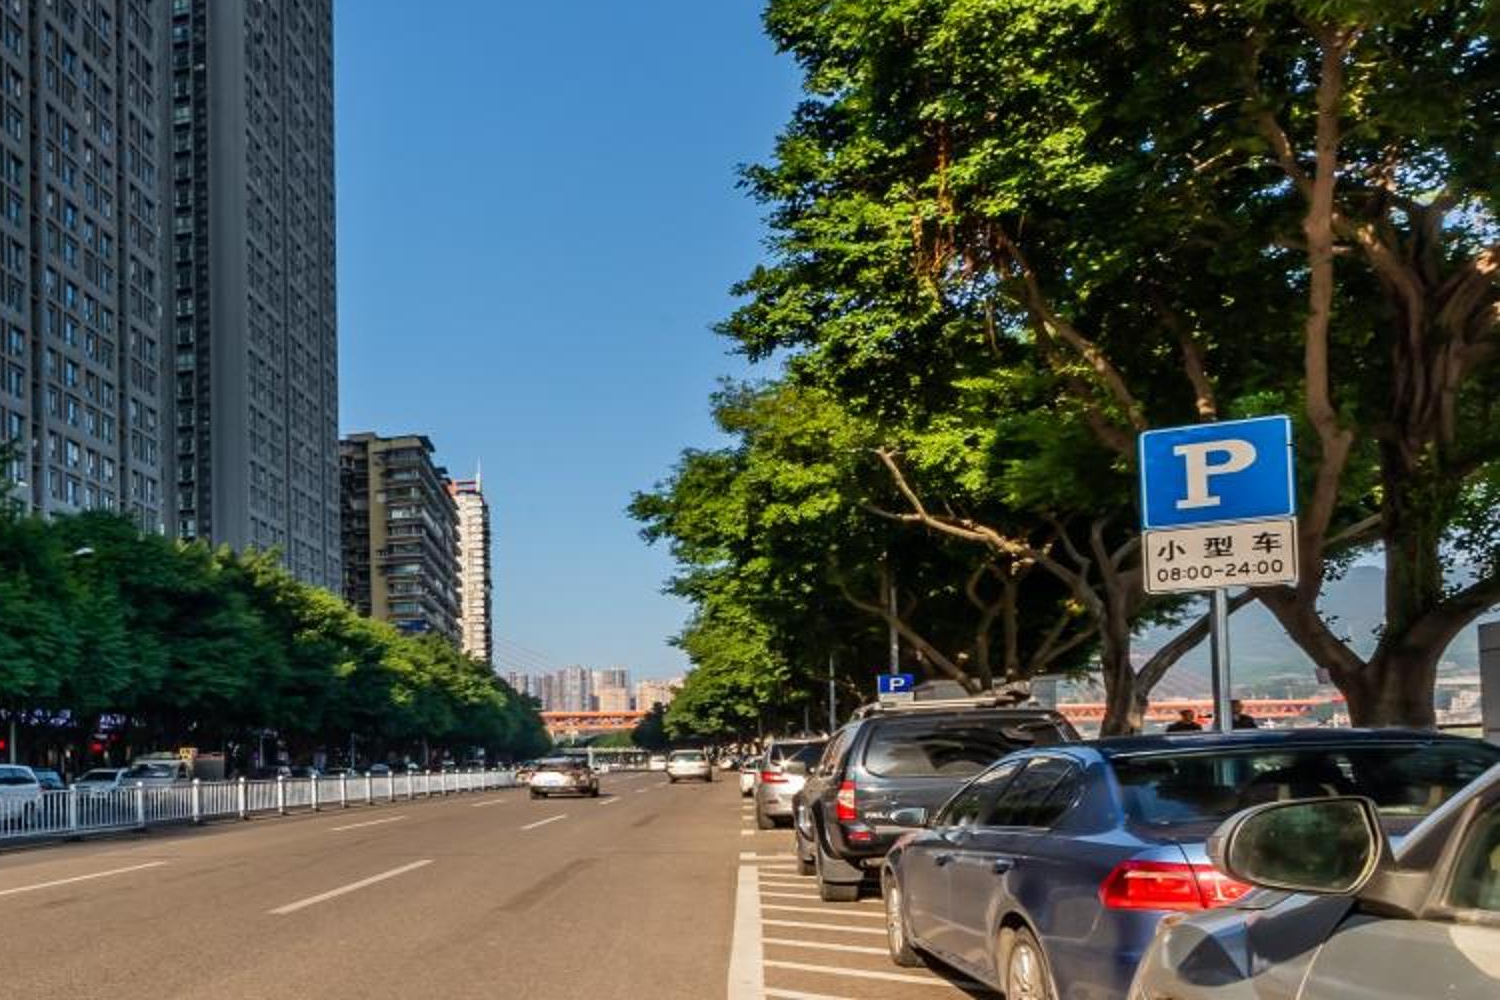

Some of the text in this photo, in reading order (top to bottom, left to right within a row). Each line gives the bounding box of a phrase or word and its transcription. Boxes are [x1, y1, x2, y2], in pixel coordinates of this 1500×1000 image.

[1173, 439, 1257, 509] P
[1157, 531, 1282, 562] 小型车
[1157, 559, 1284, 582] 08:00-24:00
[889, 677, 905, 691] P
